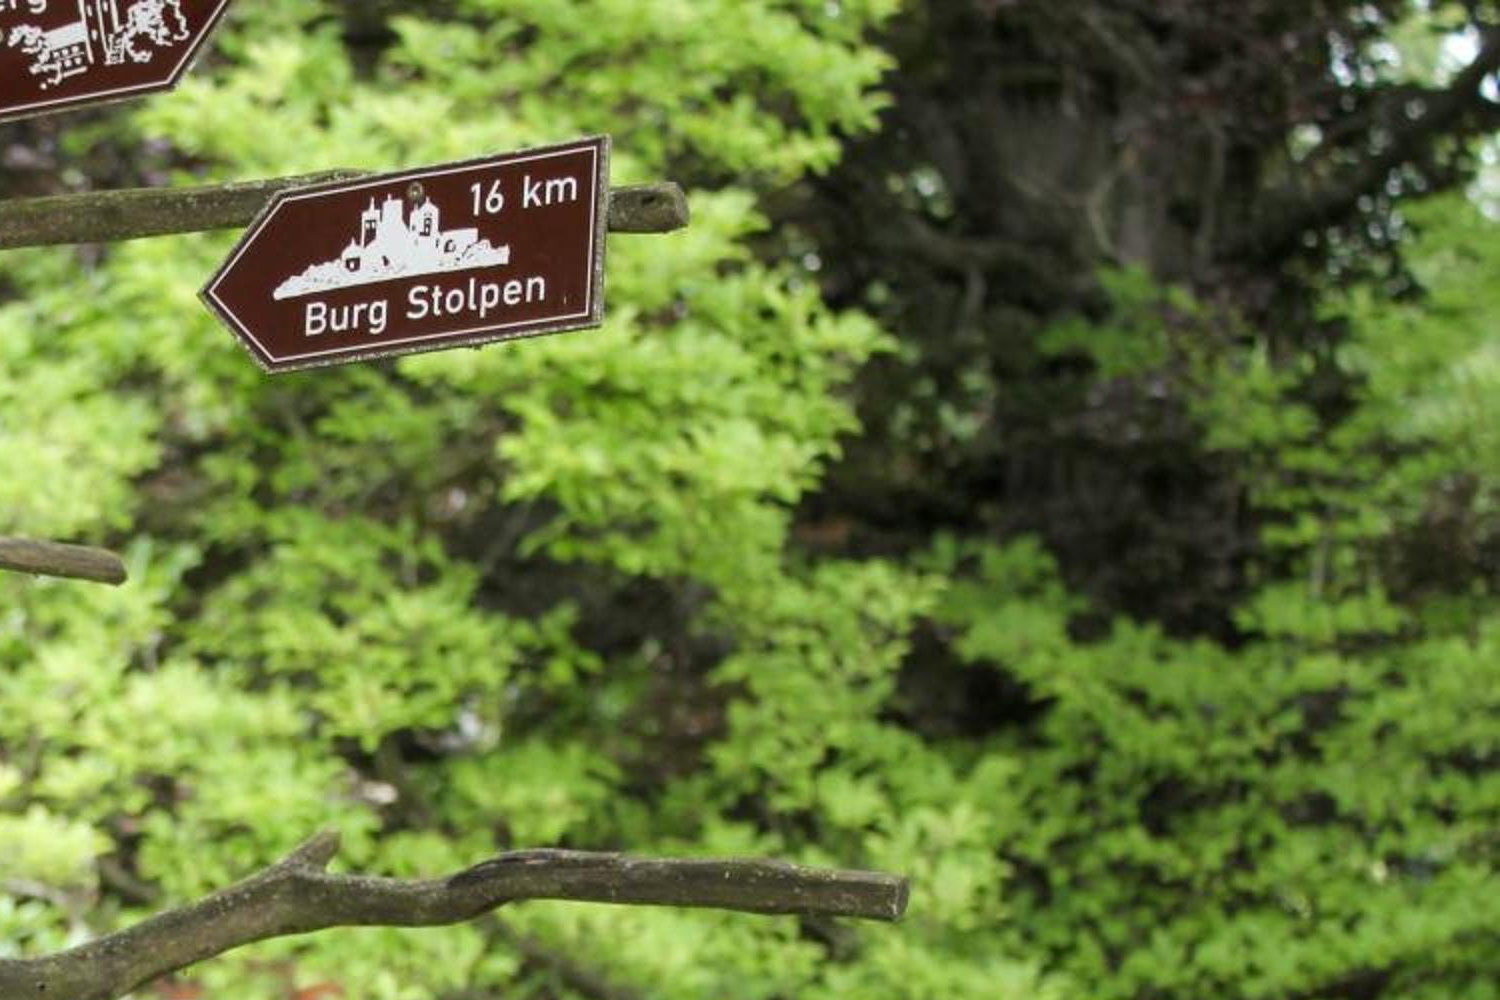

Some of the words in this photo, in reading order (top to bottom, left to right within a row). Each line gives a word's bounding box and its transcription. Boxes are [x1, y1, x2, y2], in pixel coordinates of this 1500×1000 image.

[470, 180, 504, 216] 16
[522, 175, 577, 208] km
[305, 301, 388, 336] Burg
[406, 277, 546, 319] Stolpen
